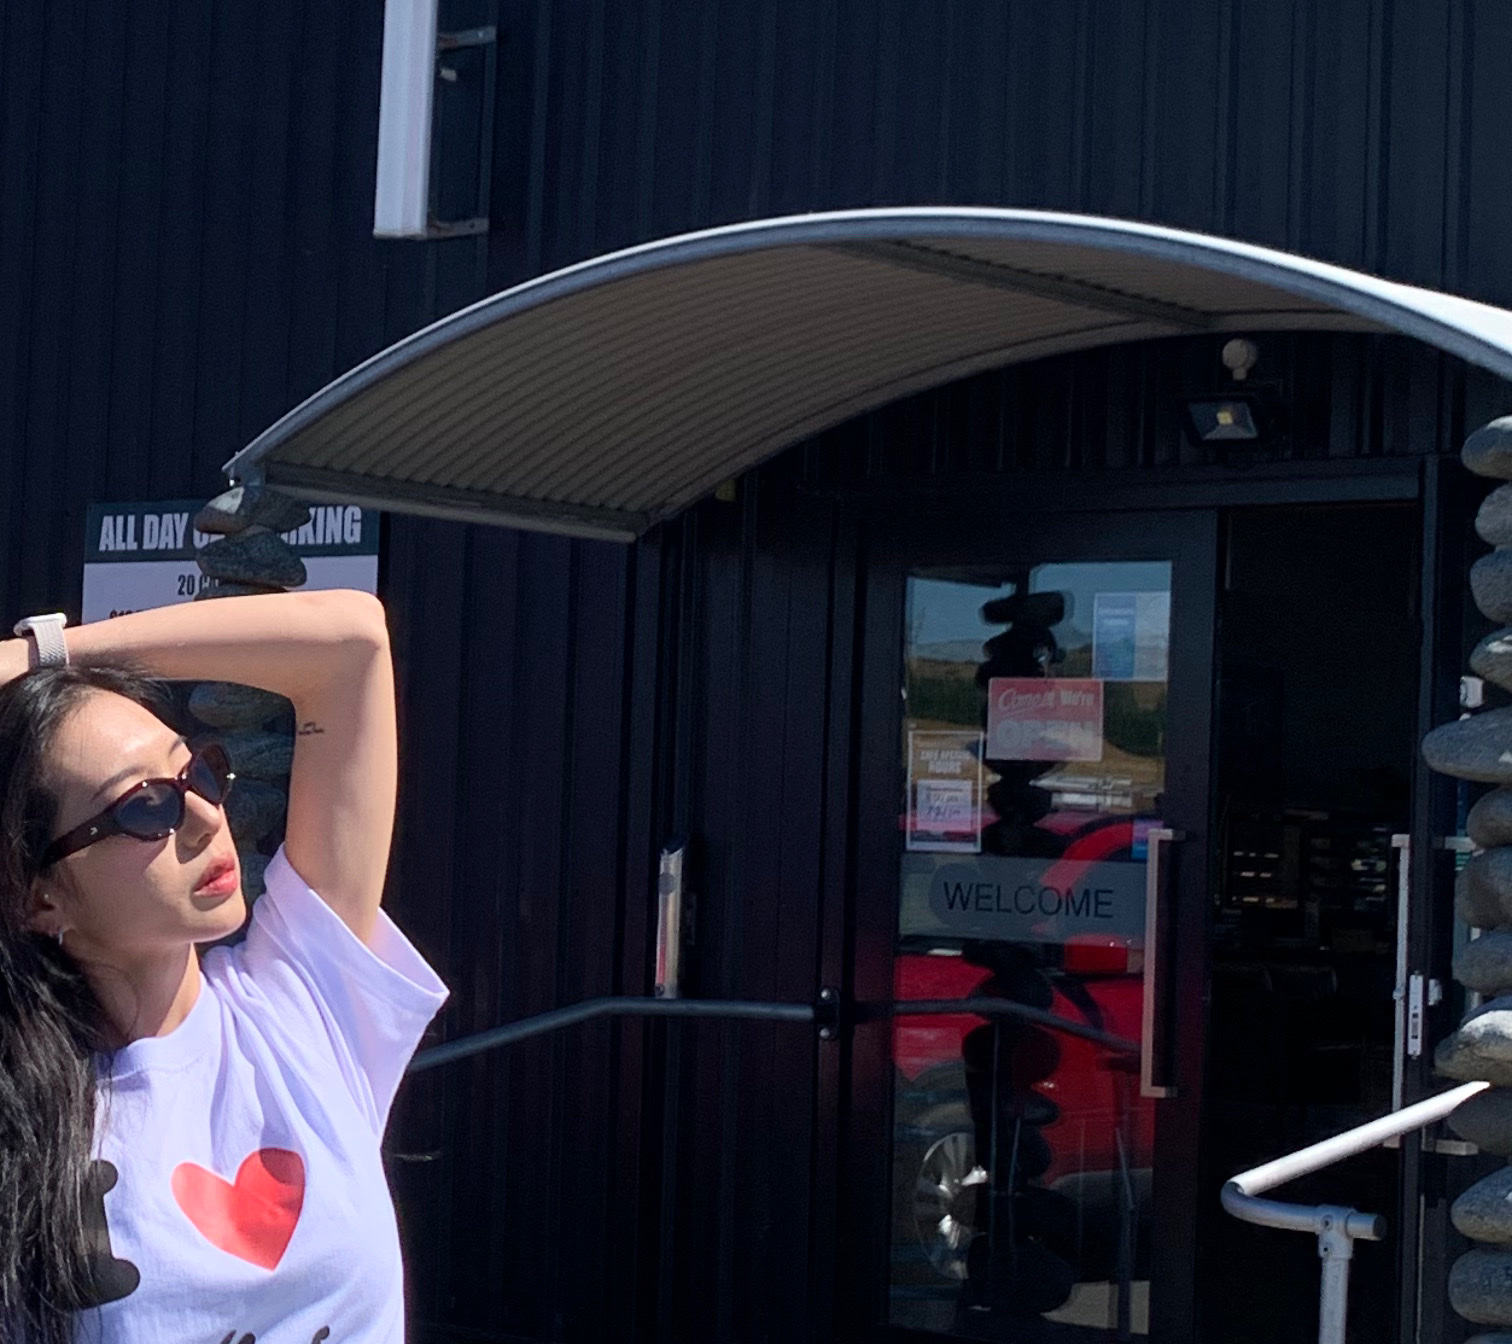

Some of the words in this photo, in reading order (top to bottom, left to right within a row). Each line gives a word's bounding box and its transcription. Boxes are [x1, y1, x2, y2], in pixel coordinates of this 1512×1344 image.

[99, 515, 138, 552] ALL
[142, 512, 189, 551] DAY
[177, 574, 195, 596] 20
[997, 720, 1095, 750] OPEN
[943, 881, 1114, 919] WELCOME
